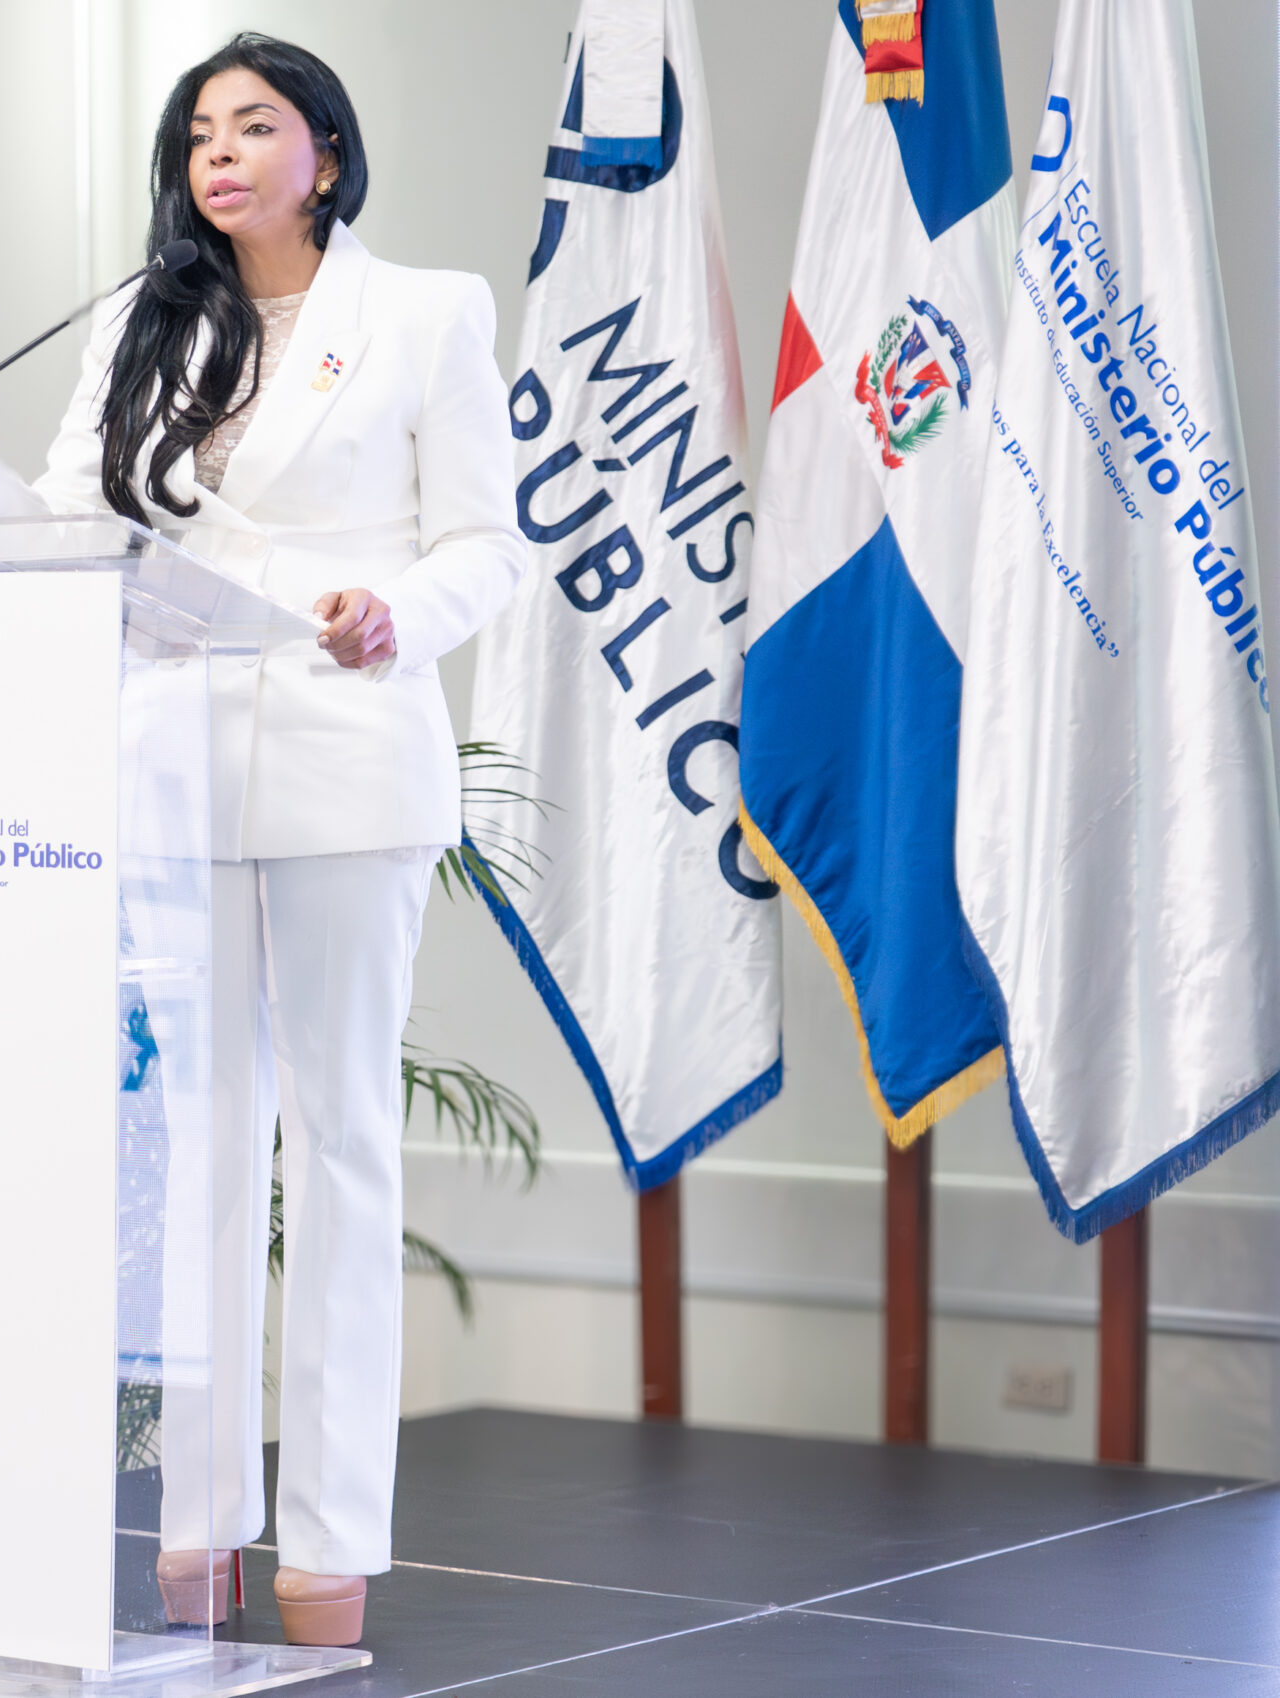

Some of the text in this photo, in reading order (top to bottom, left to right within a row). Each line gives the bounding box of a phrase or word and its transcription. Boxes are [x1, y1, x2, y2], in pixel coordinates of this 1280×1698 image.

[1014, 248, 1049, 326] Instituto
[1052, 348, 1102, 441] Educación
[1097, 441, 1144, 521] Superior
[1038, 211, 1181, 495] Ministerio
[1064, 178, 1245, 511] Escuela Nacional del
[1002, 438, 1039, 495] para
[7, 818, 29, 837] del
[13, 842, 103, 870] Público
